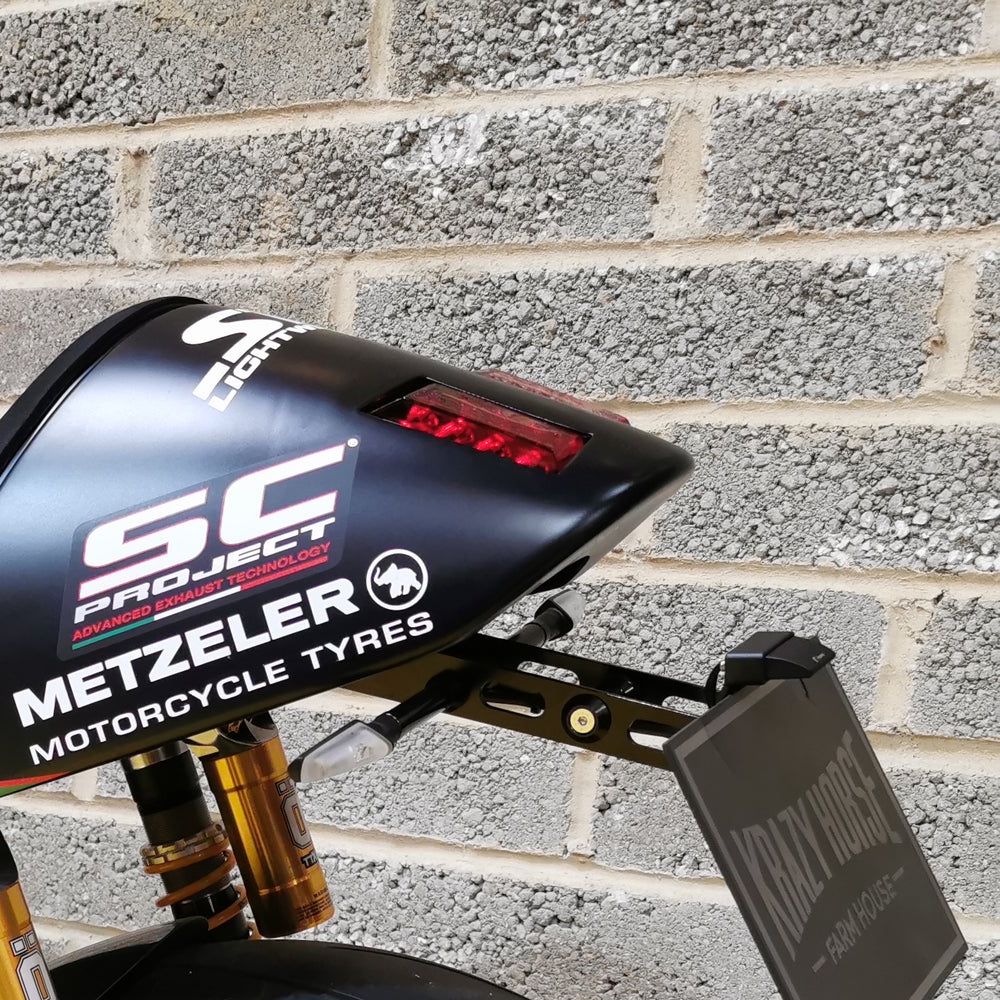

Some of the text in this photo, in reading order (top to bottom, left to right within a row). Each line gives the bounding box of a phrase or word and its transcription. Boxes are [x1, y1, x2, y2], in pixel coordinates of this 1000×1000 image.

[72, 542, 331, 641] ADVANCED EXHAUST TECHNOLOGY
[74, 517, 336, 624] PROJECT
[78, 443, 346, 601] SC
[13, 578, 360, 728] METZELER
[29, 611, 435, 766] MOTORCYCLE TYRES
[729, 797, 833, 963] KRAZY
[826, 873, 898, 965] FARM HOUSE
